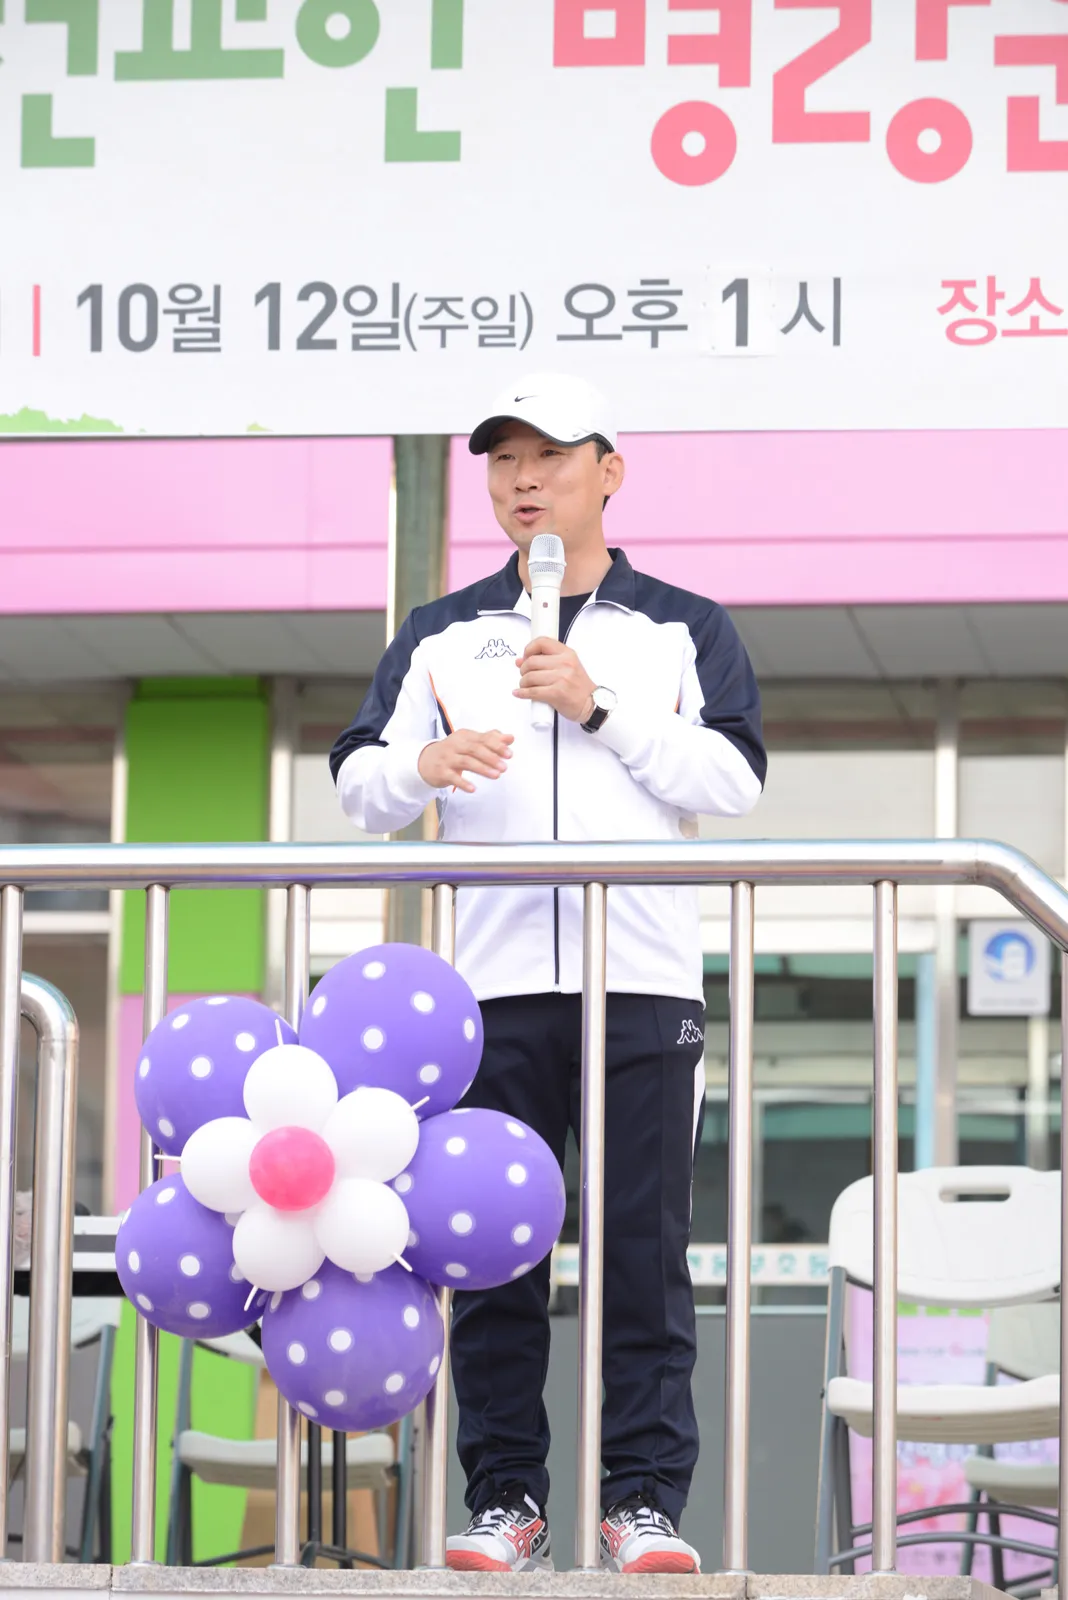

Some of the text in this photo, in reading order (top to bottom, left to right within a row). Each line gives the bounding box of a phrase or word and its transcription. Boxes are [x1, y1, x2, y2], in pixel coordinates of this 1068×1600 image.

[77, 283, 221, 353] 10월
[255, 281, 533, 351] 12일(주일)
[557, 279, 688, 348] 오후
[937, 276, 1068, 346] 장소
